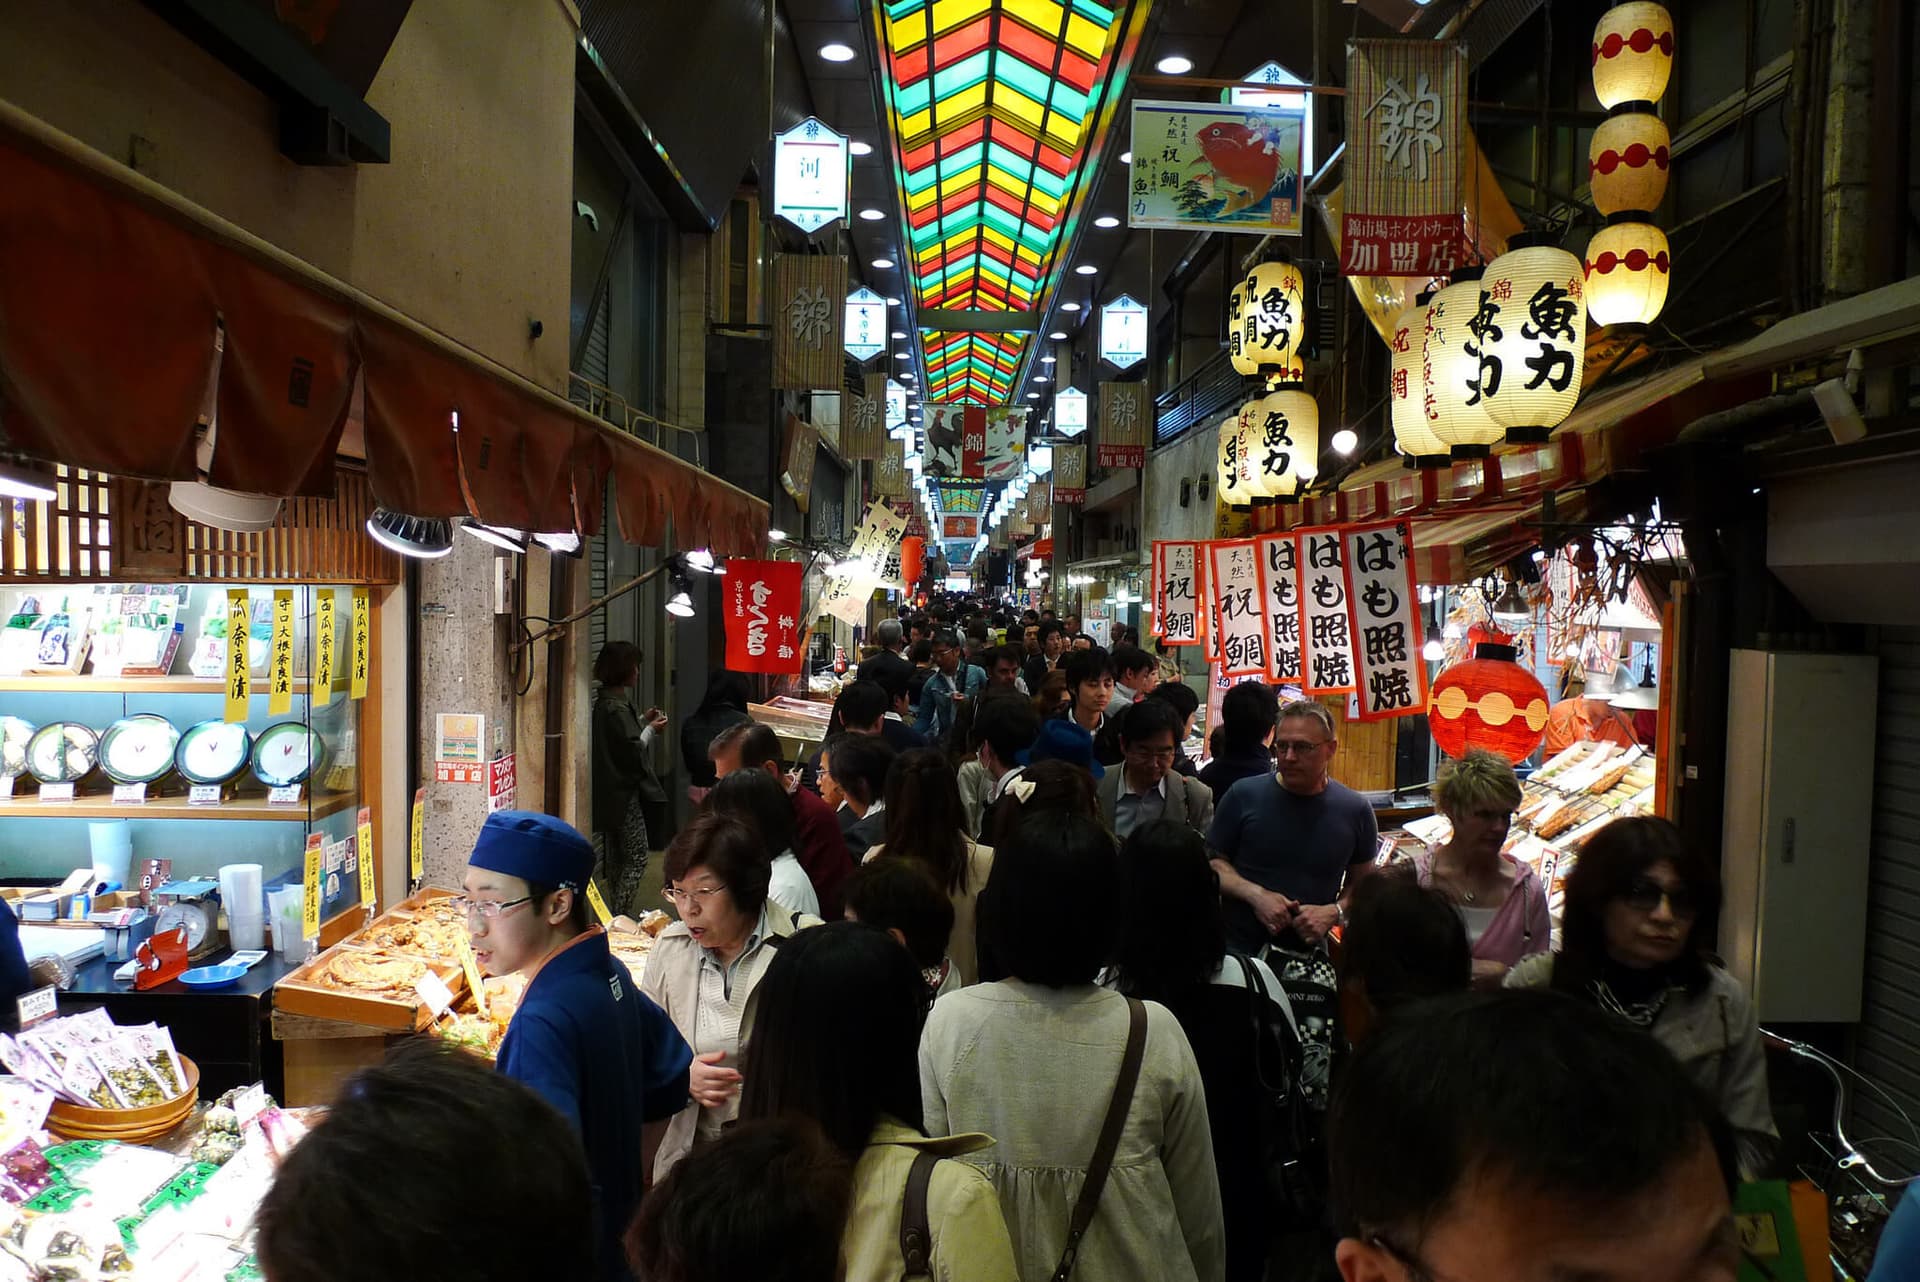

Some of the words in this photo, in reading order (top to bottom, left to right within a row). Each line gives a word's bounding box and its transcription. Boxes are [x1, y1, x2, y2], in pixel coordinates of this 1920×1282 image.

[1363, 72, 1444, 182] 錦
[1132, 177, 1150, 216] 魚力
[1160, 145, 1181, 189] 祝鯛
[1346, 239, 1457, 273] 加盟店
[1347, 218, 1460, 239] 錦市場ポイントカード
[781, 284, 832, 352] 錦
[1260, 287, 1292, 351] 魚力
[1491, 278, 1513, 302] 錦
[1567, 276, 1583, 303] 錦
[1520, 281, 1579, 393] 魚力
[1110, 392, 1138, 431] 錦
[1262, 411, 1291, 476] 魚力
[355, 597, 367, 680] 胡瓜奈良漬
[1166, 573, 1195, 639] 祝鯛
[1219, 584, 1266, 671] 祝鯛
[1307, 535, 1350, 688] はも照焼
[1357, 533, 1412, 712] はも照焼
[231, 597, 247, 700] 瓜奈良漬
[275, 597, 291, 694] 守口大根奈良漬
[317, 597, 332, 686] 西瓜奈良漬
